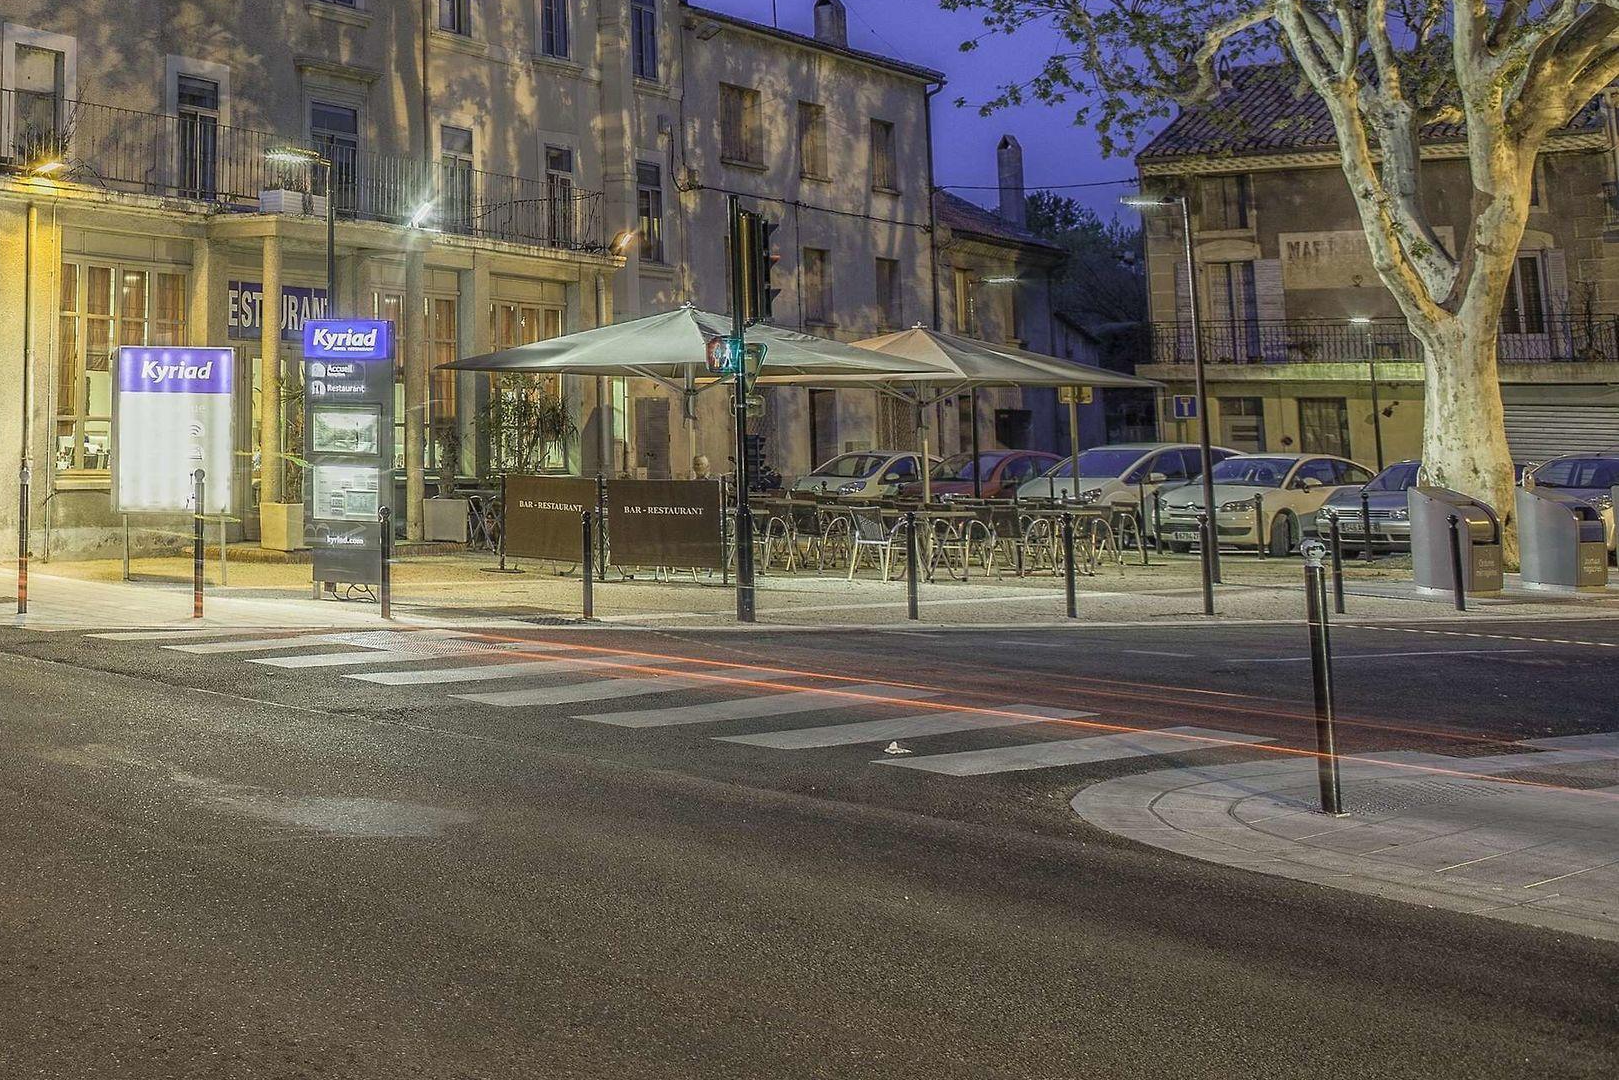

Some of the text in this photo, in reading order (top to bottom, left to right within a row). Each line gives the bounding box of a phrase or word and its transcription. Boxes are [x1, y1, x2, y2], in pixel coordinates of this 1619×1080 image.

[312, 328, 378, 351] Kyriad
[141, 360, 213, 384] Kyriad
[327, 364, 353, 373] Accueil
[327, 384, 365, 393] Restaurant
[519, 500, 534, 508] BAR
[538, 502, 583, 512] RESTAURANT
[624, 506, 642, 514] BAR
[647, 507, 704, 515] RESTAURANT
[326, 535, 364, 546] kyriad.com
